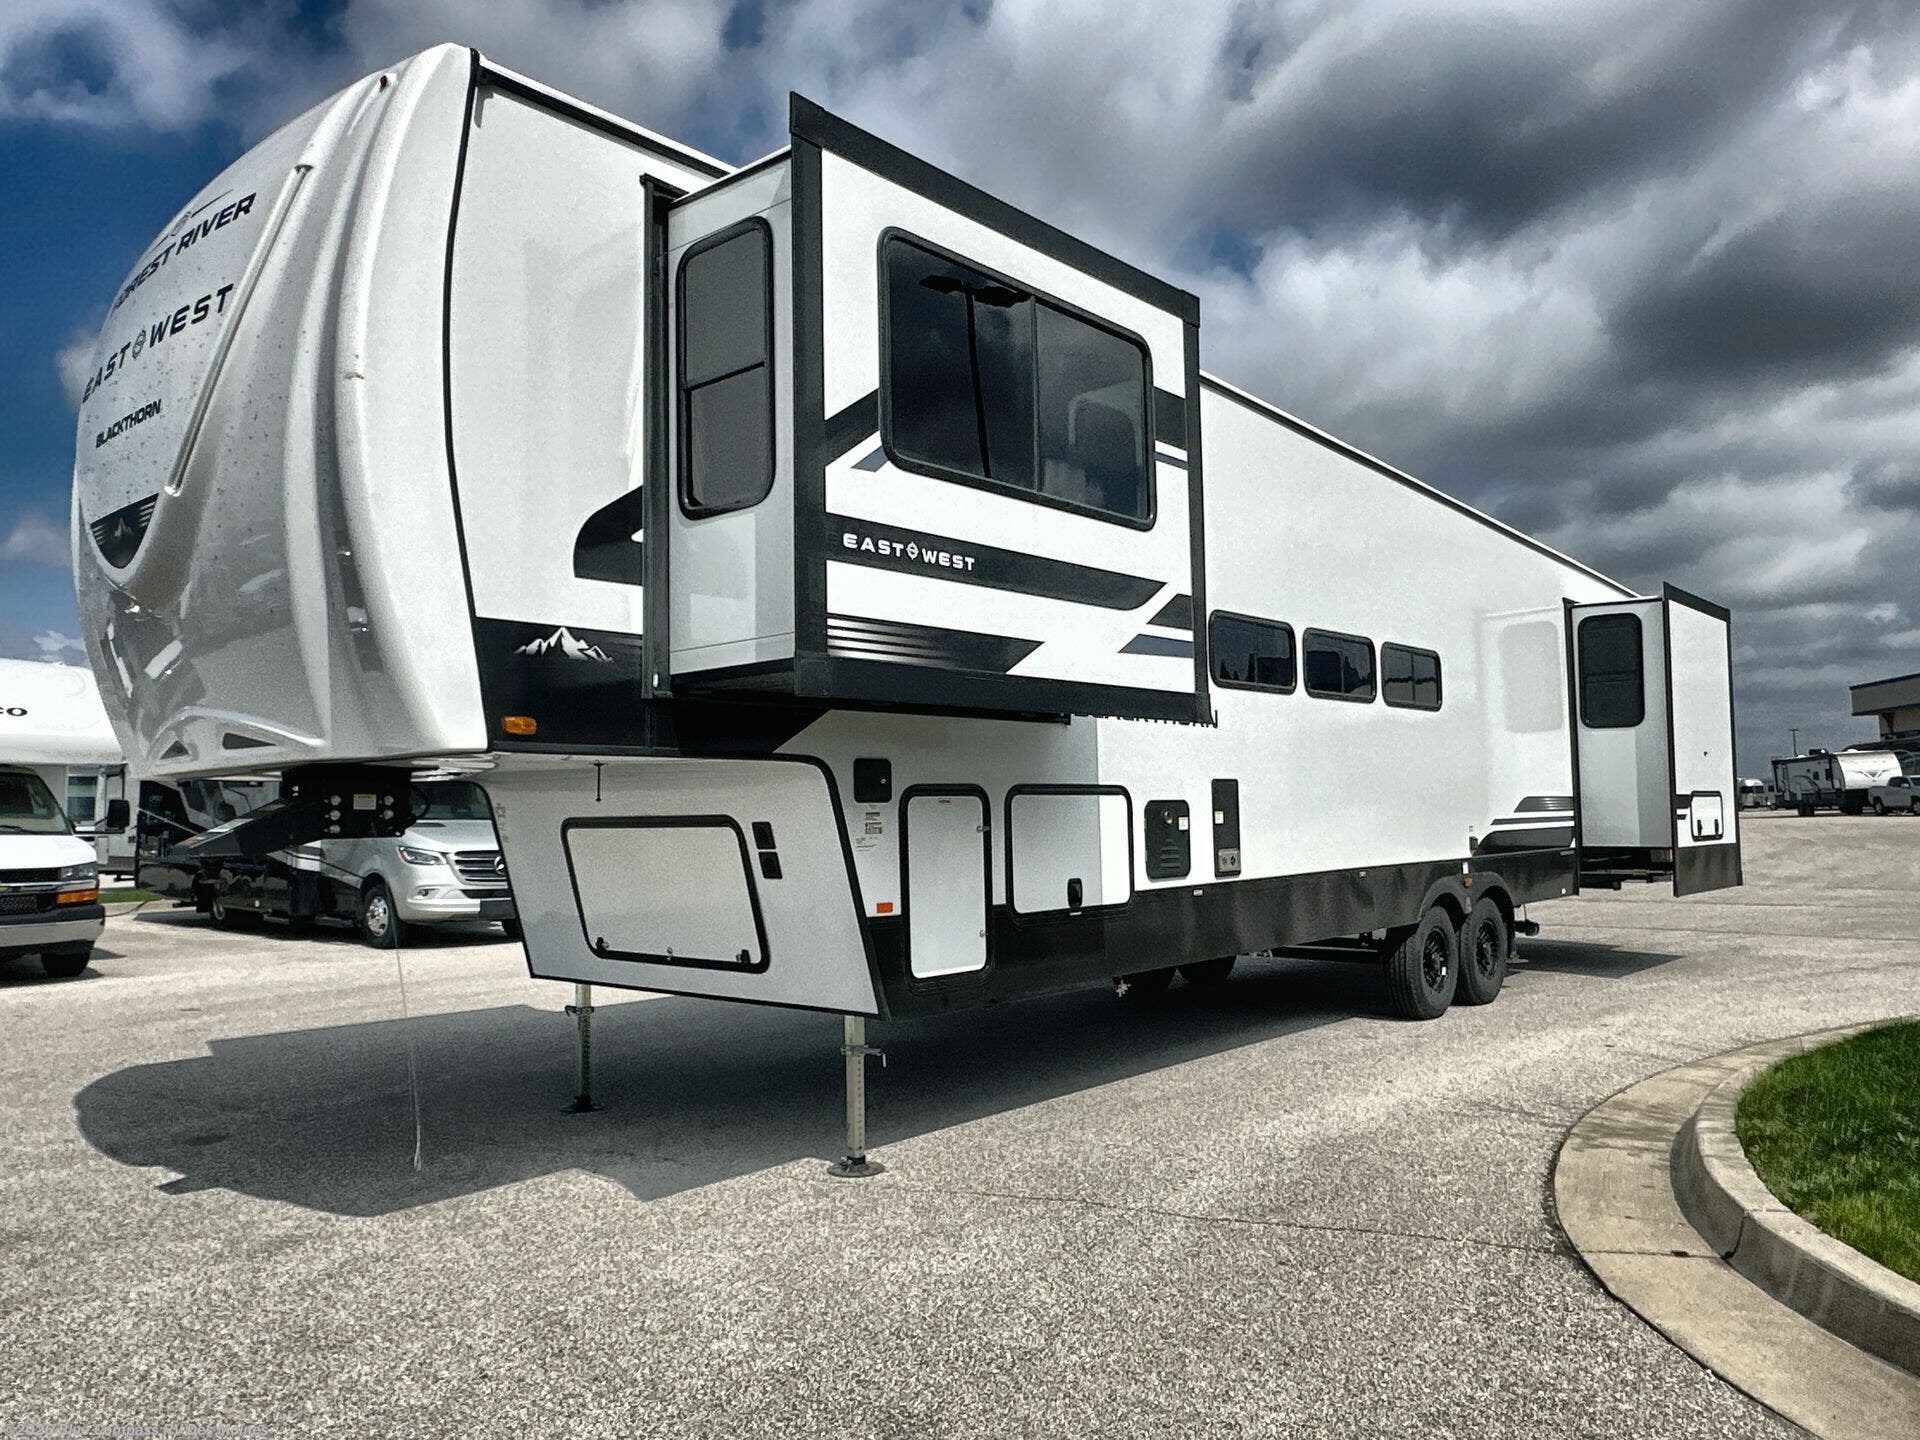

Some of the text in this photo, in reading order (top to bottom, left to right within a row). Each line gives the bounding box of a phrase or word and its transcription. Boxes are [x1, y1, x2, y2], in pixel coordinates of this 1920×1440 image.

[176, 192, 257, 255] RIVER
[82, 283, 234, 404] EAST WEST
[95, 399, 162, 449] BLACKTHORN
[842, 532, 975, 571] EAST WEST
[0, 706, 28, 717] O
